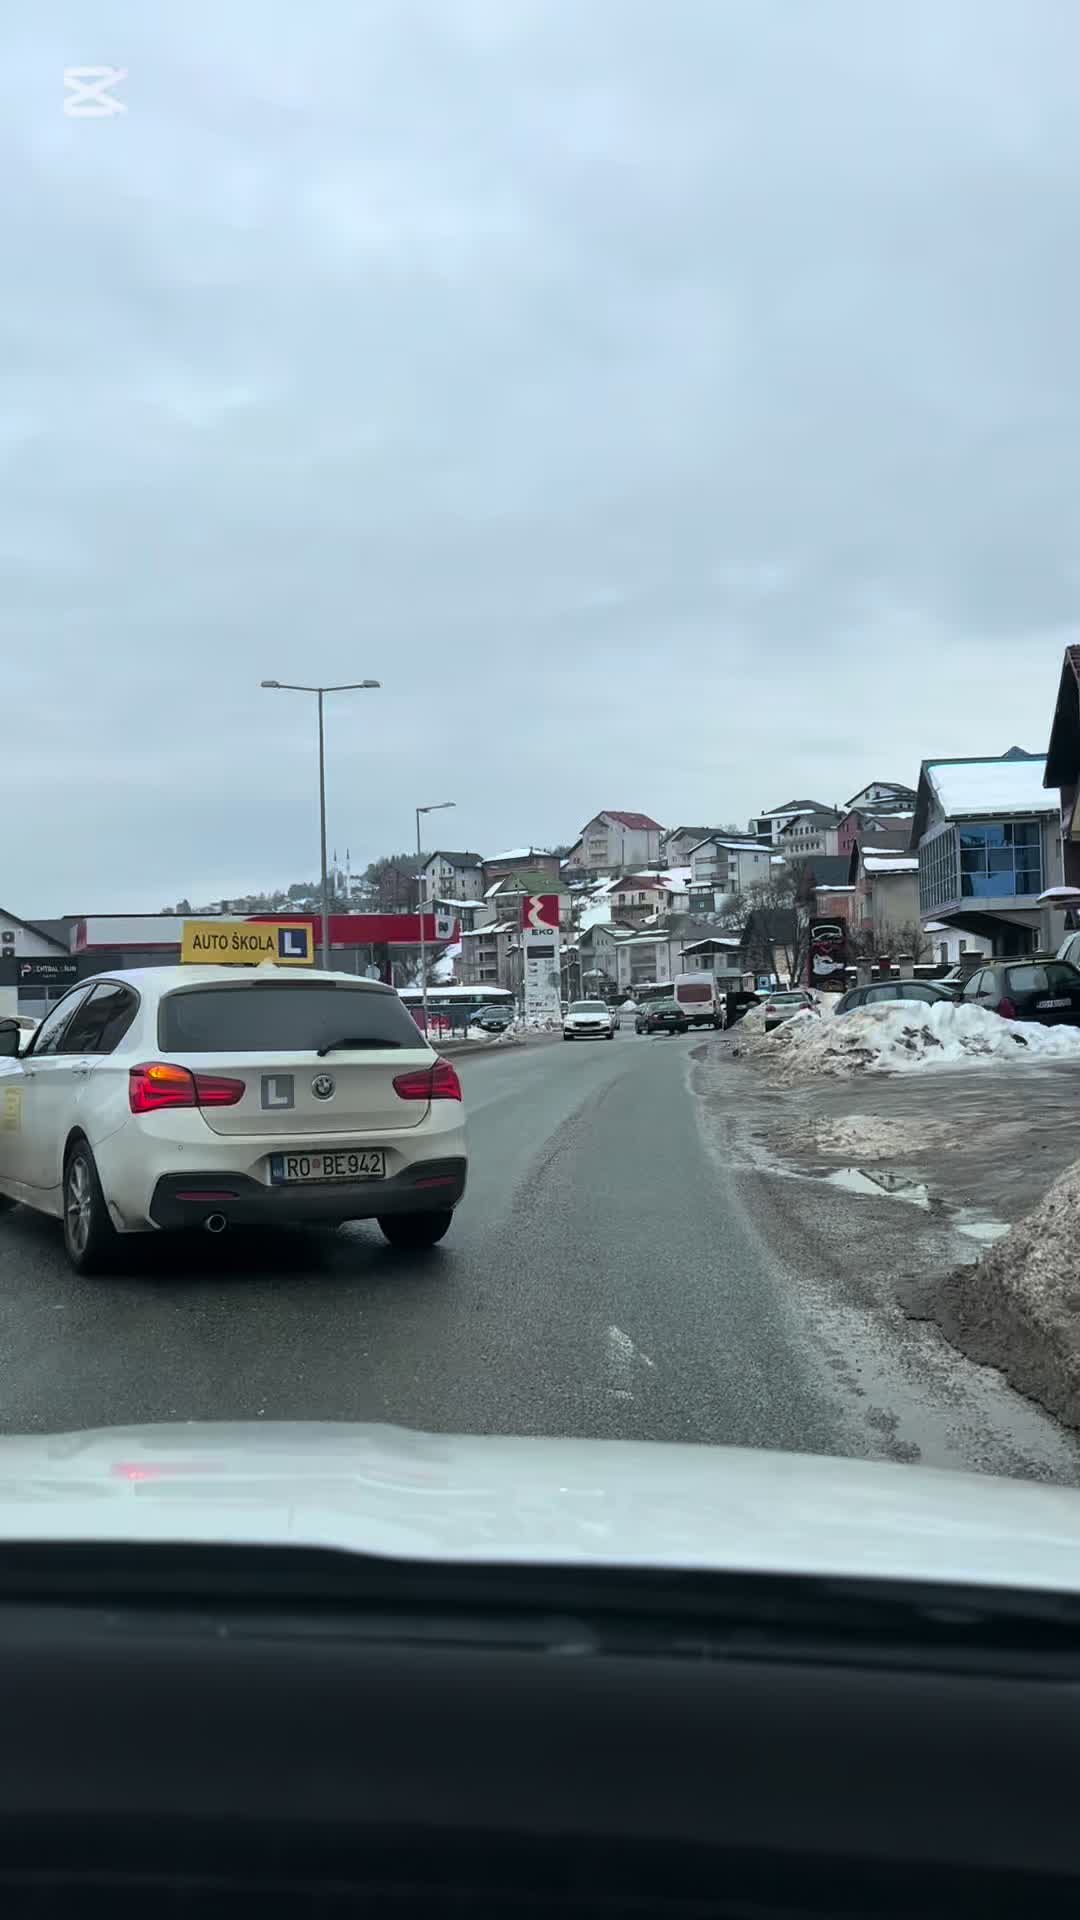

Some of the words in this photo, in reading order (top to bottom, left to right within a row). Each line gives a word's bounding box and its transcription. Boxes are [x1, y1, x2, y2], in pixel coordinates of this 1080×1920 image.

[192, 934, 229, 950] AUTO
[231, 931, 275, 951] ŠKOLA
[284, 931, 302, 954] L
[531, 928, 555, 936] EKO
[268, 1079, 288, 1105] L
[287, 1157, 311, 1177] RO
[323, 1153, 381, 1176] BE942
